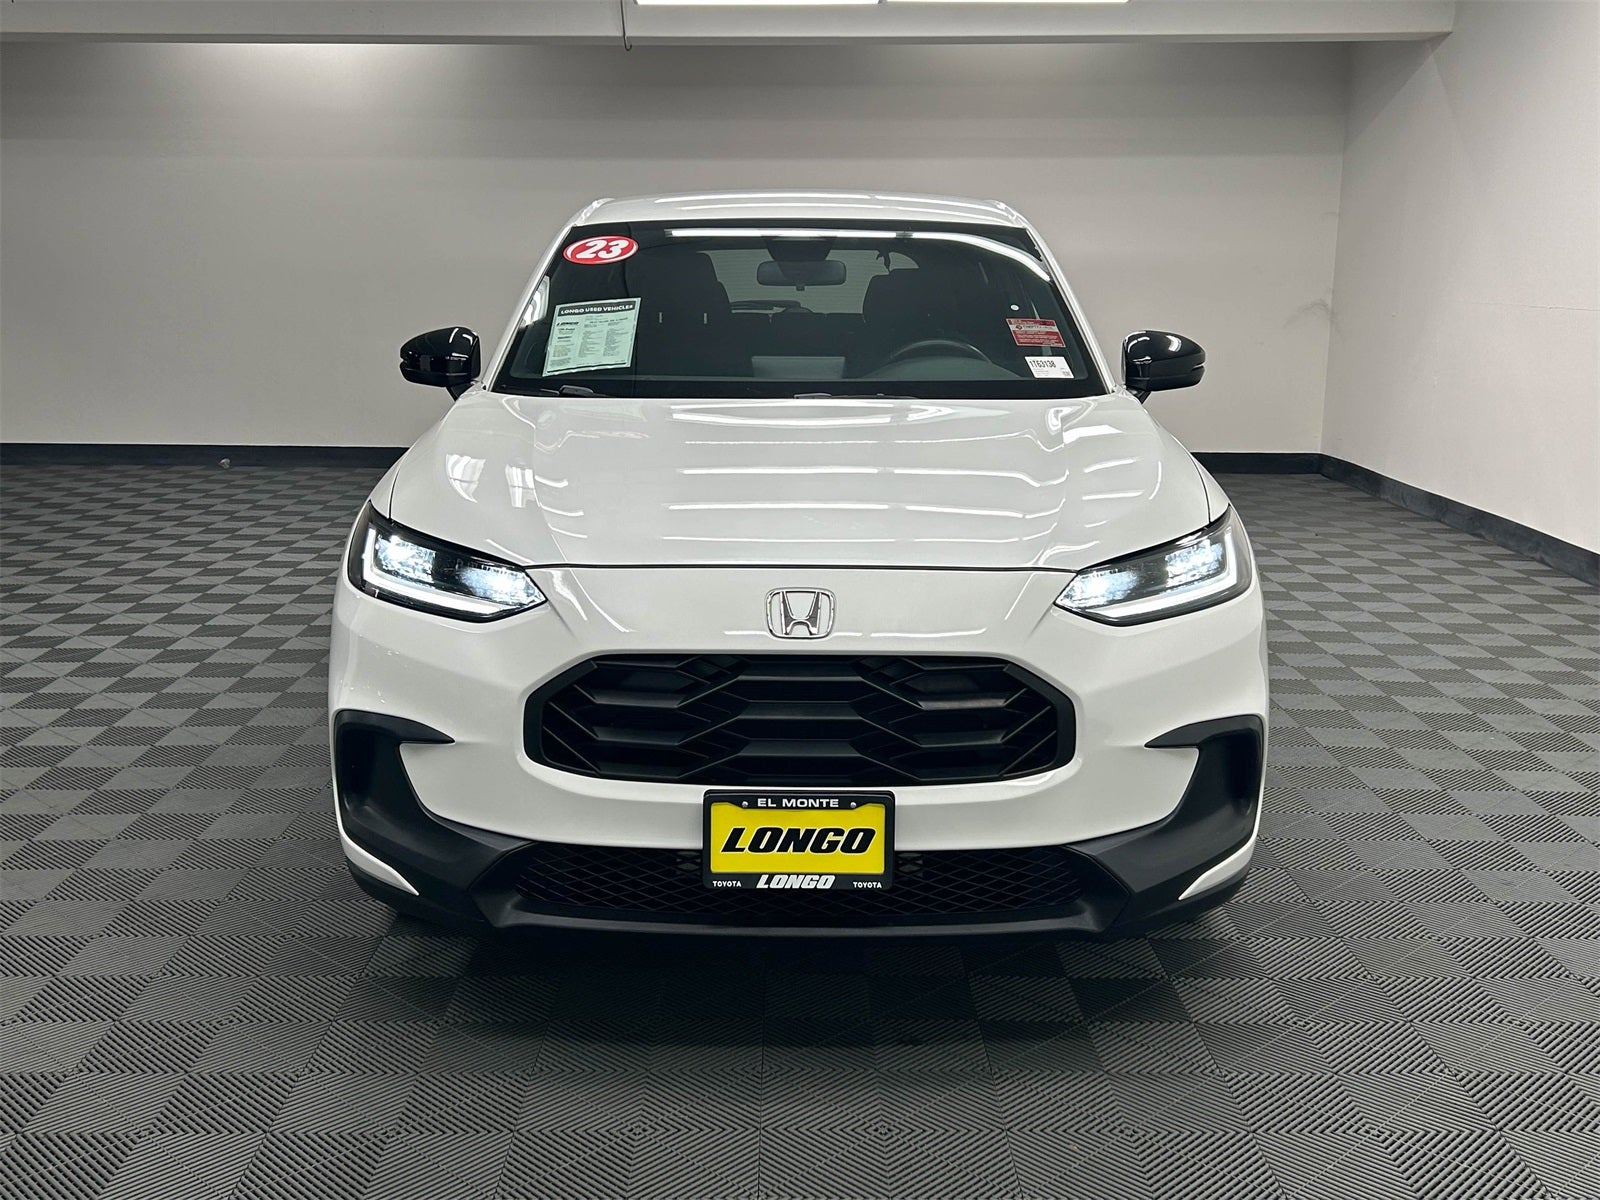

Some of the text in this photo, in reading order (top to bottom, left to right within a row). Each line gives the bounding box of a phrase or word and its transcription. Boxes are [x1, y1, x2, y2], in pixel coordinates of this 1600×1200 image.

[575, 239, 630, 259] 23
[560, 307, 585, 315] LONGO
[603, 304, 633, 312] VEHICLES
[757, 798, 839, 808] EL MONTE
[720, 826, 877, 854] LONGO
[712, 880, 742, 888] TOYOTA
[756, 874, 836, 889] LONGO
[852, 881, 882, 889] TOYOTA
